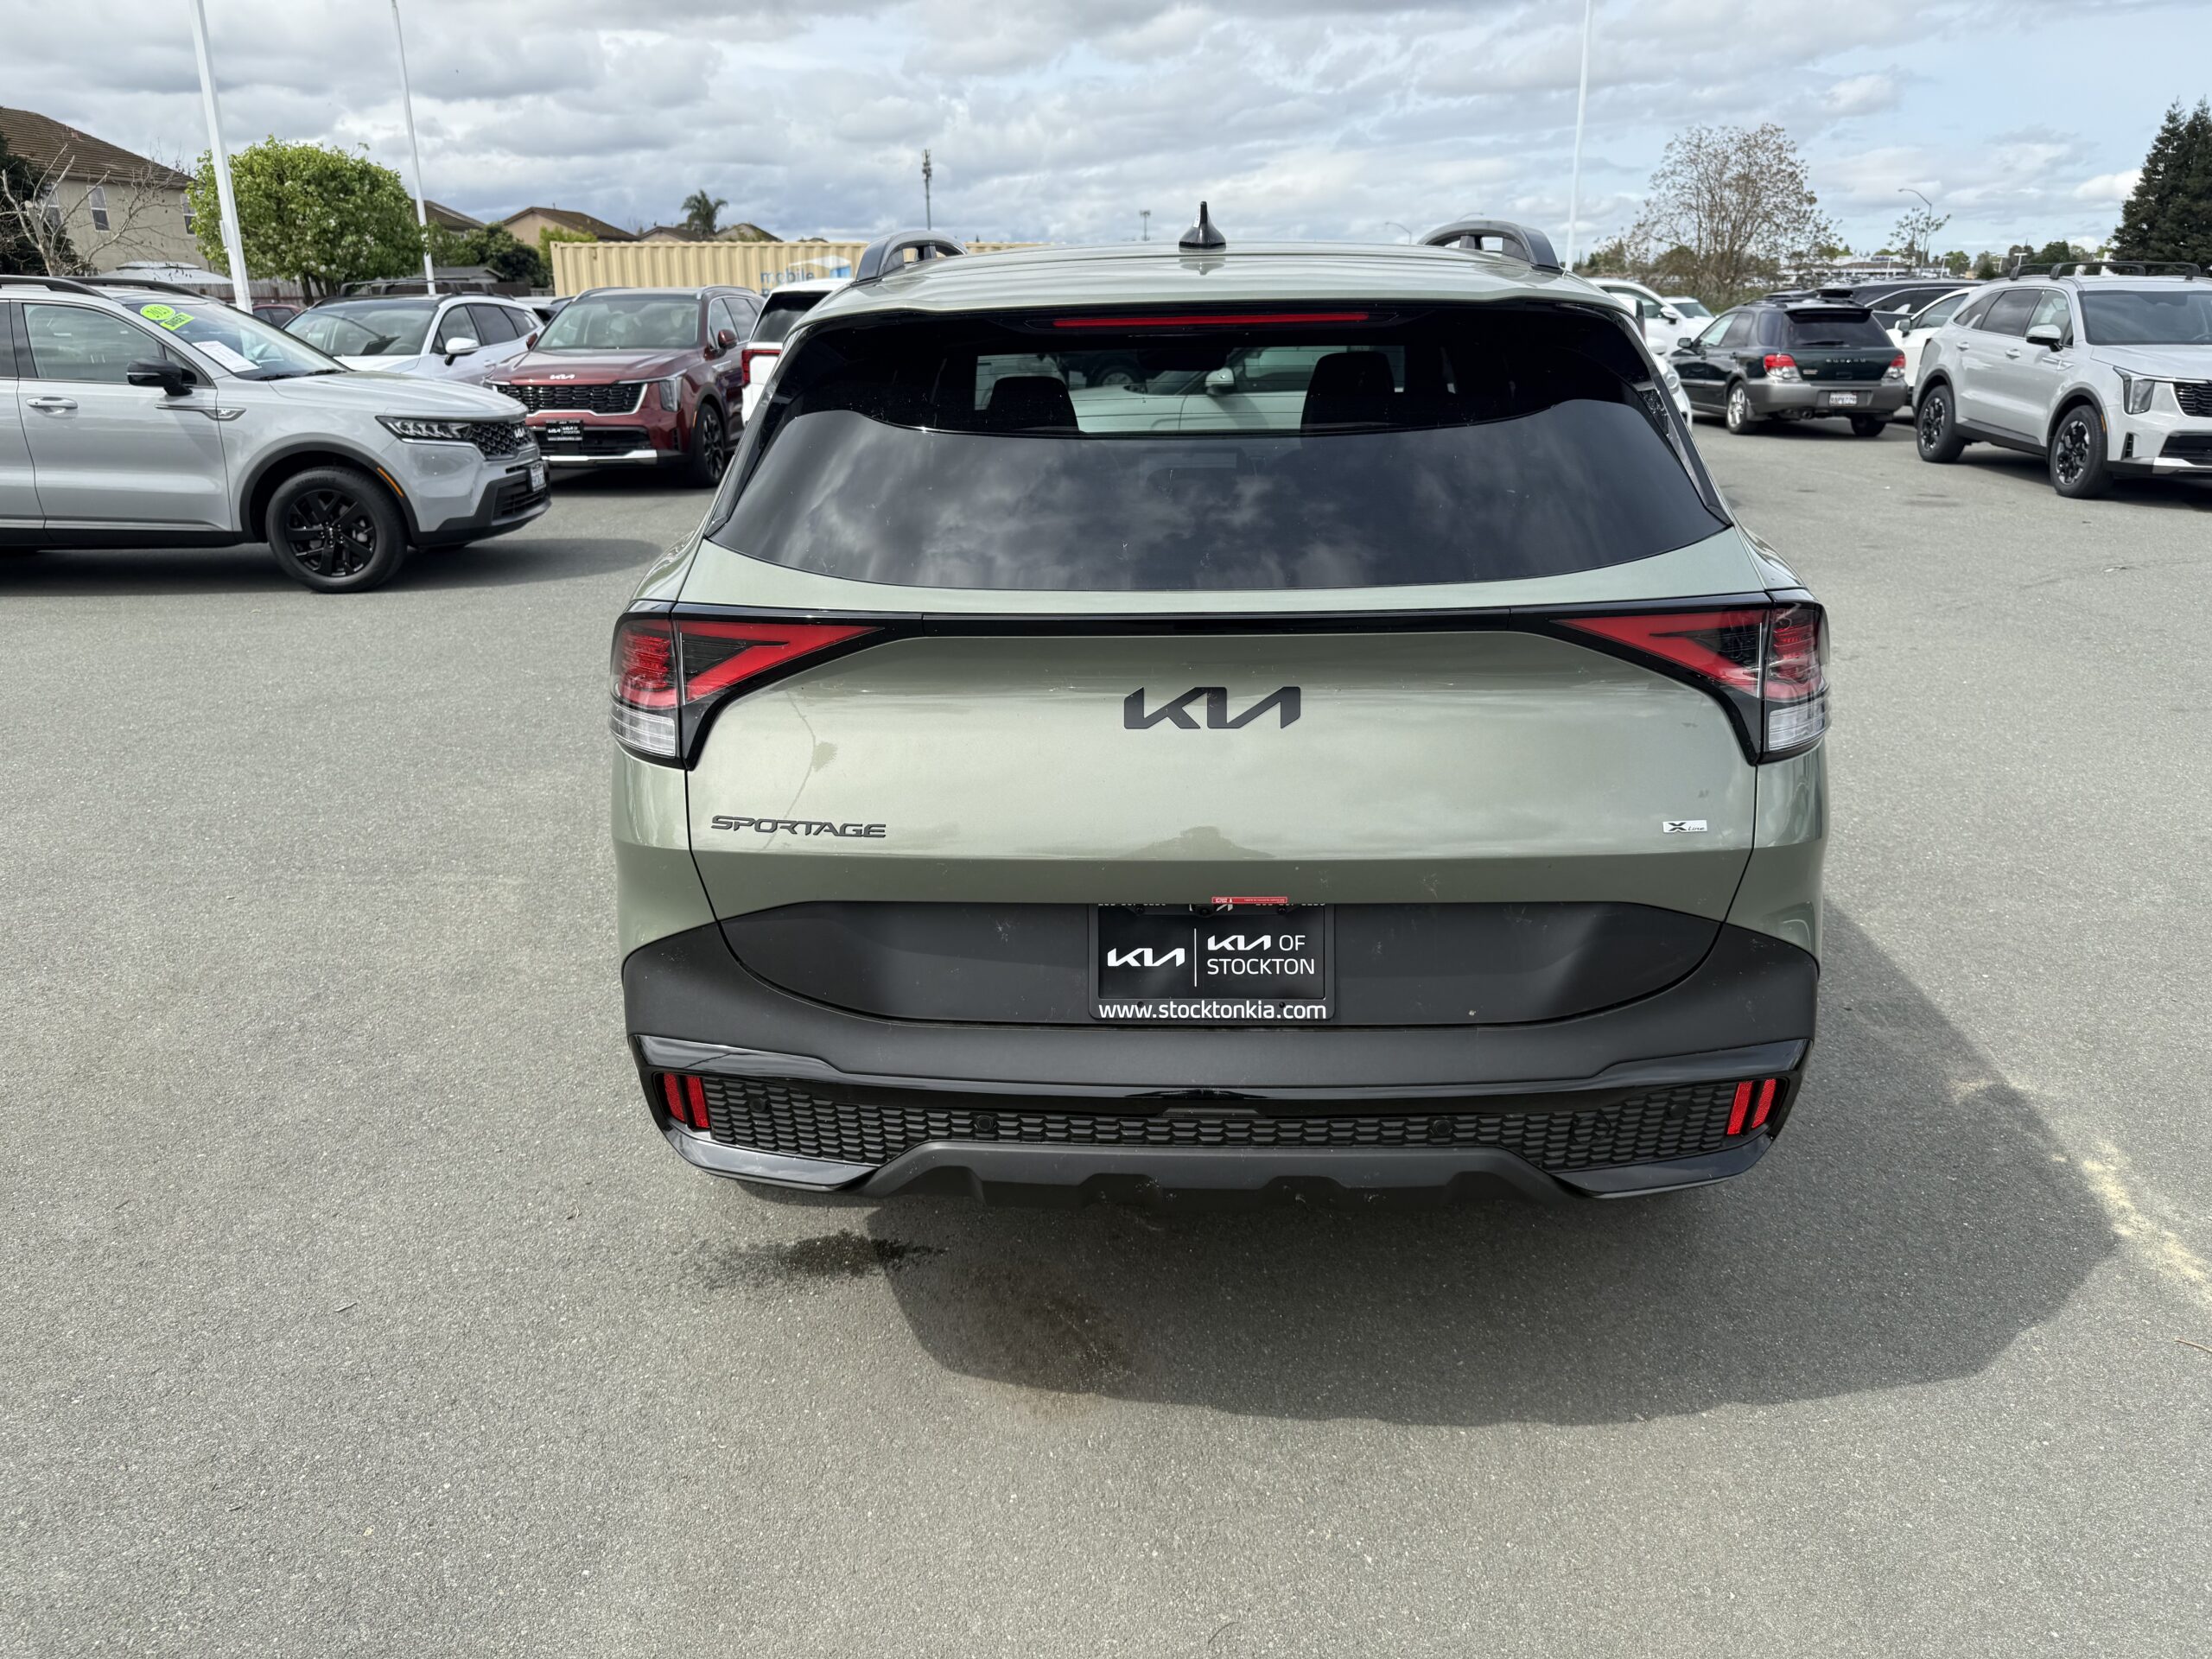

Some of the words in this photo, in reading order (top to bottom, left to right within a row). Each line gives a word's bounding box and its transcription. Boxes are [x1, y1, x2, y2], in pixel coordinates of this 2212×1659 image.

[760, 267, 816, 283] mobile
[1124, 686, 1300, 729] KIA
[711, 815, 887, 838] SPORTAGE
[1208, 934, 1272, 950] KIA
[1279, 934, 1306, 951] OF
[1107, 947, 1185, 967] KIA
[1206, 957, 1315, 976] STOCKTON
[1098, 1001, 1327, 1020] www.stocktonkia.com
